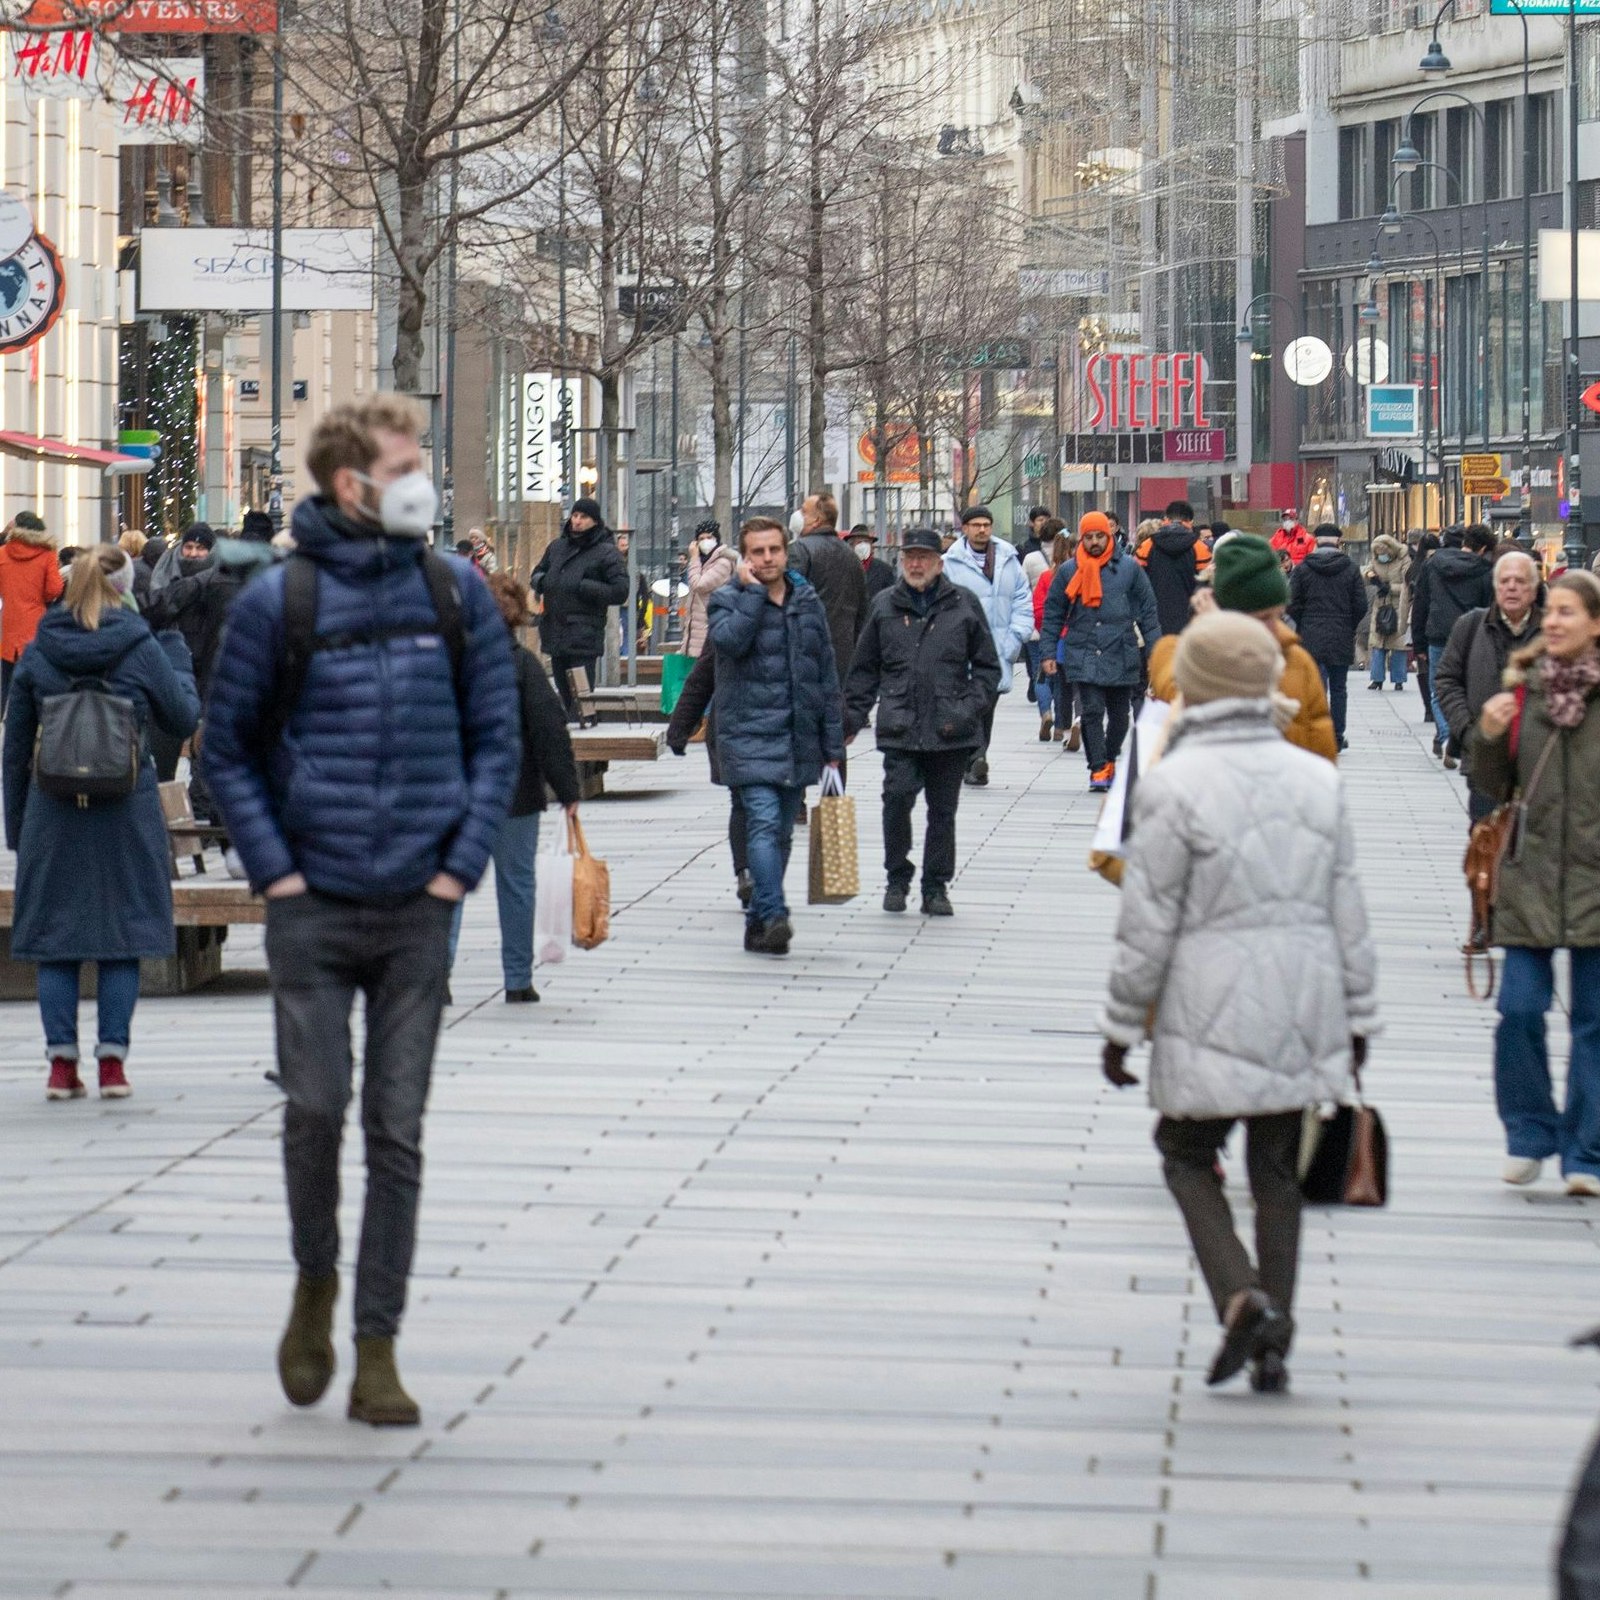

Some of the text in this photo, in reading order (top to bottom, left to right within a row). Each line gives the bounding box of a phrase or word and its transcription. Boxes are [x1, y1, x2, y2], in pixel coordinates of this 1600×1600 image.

[88, 1, 239, 20] SOUVENIRS
[14, 31, 93, 80] H&M
[122, 77, 197, 126] H&M
[193, 256, 314, 275] SEACRT
[1085, 351, 1211, 428] STEFFL
[526, 381, 545, 492] MANGO
[1175, 432, 1212, 452] STEFFL
